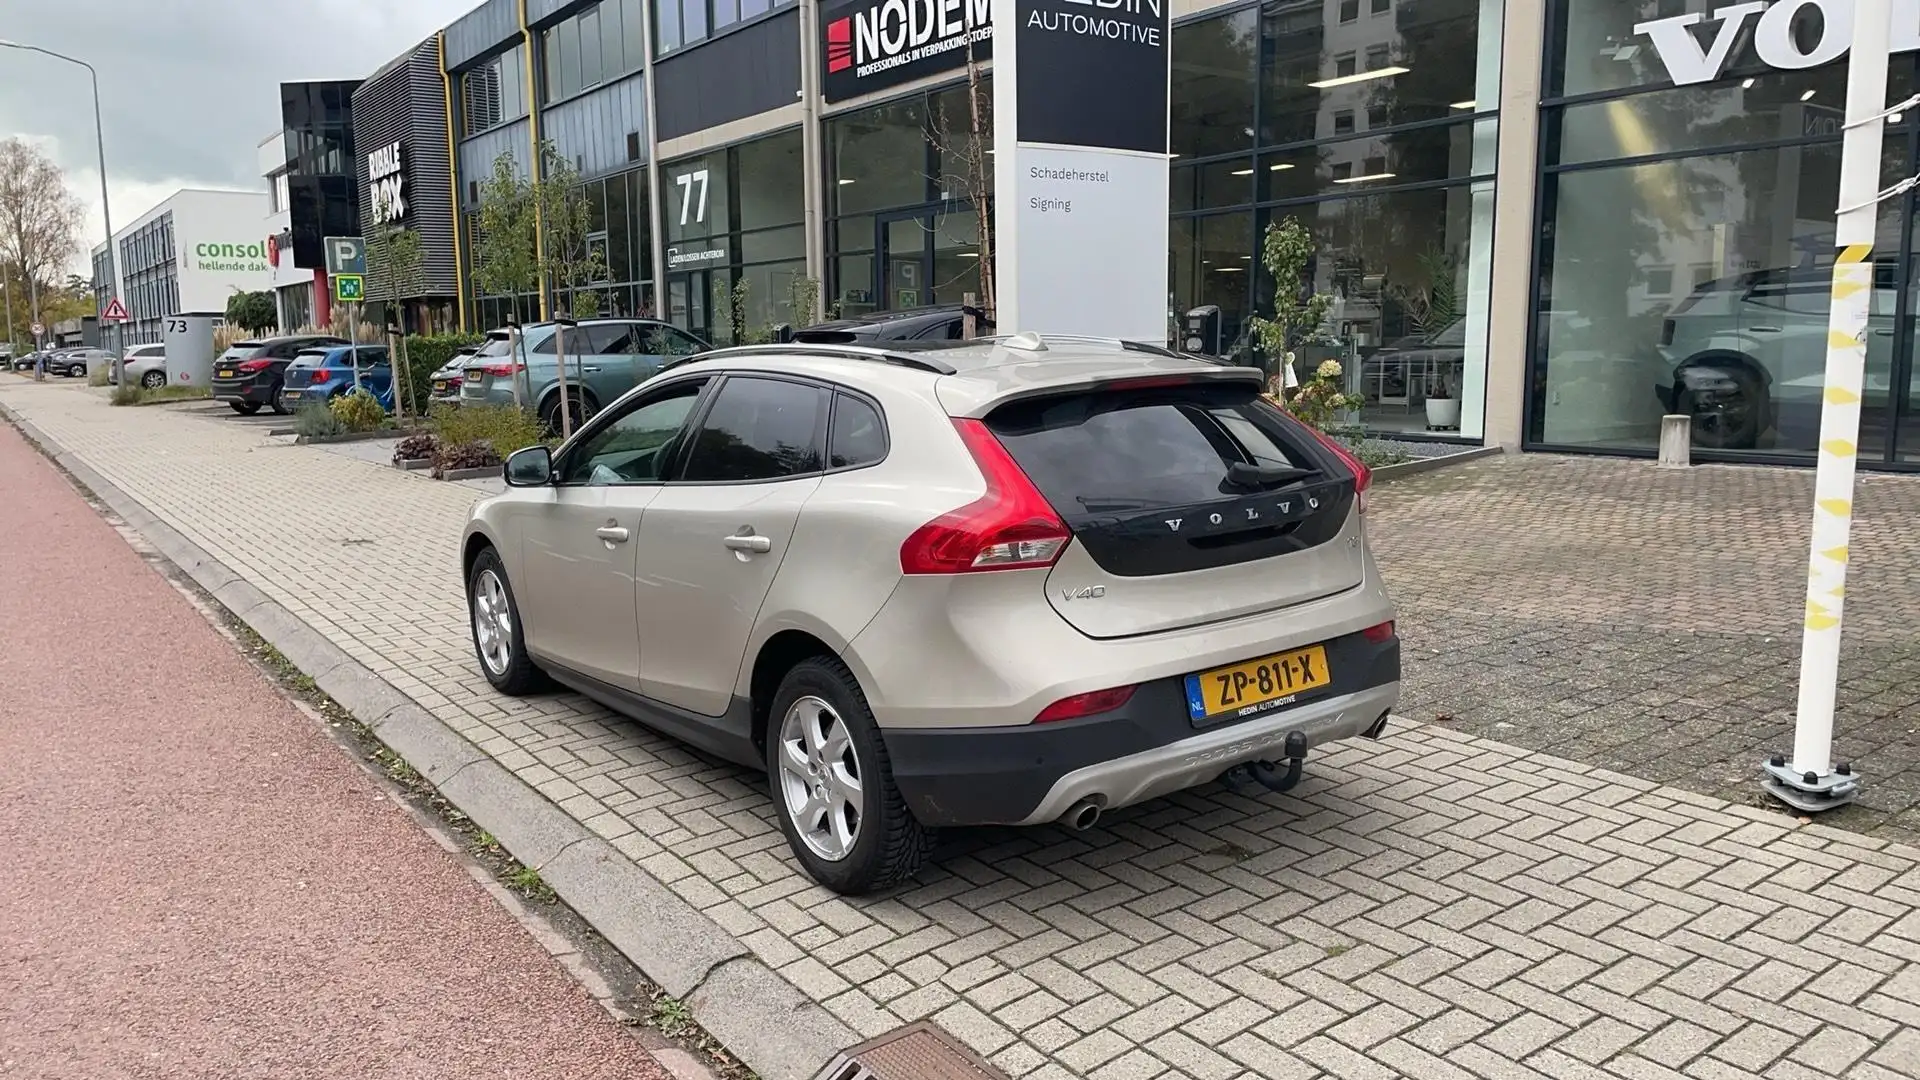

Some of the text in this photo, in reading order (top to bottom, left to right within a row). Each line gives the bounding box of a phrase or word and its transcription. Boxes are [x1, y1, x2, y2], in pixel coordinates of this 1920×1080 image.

[1028, 9, 1160, 47] AUTOMOTIVE
[1634, 0, 1920, 86] VO
[857, 52, 911, 78] PROFESSIONALS
[912, 50, 921, 61] IN
[368, 141, 401, 181] RIBBLE
[1030, 166, 1109, 182] Schadeherstel
[370, 173, 404, 225] BOX
[676, 169, 709, 226] 77
[1030, 197, 1072, 213] Signing
[196, 240, 267, 258] consol
[334, 240, 357, 271] P
[198, 260, 246, 272] hellende
[167, 320, 188, 334] 73
[1165, 497, 1320, 532] VOLVO
[1062, 585, 1106, 601] V40
[1216, 653, 1316, 707] ZP-811-X
[1191, 702, 1204, 713] NL
[1238, 694, 1297, 717] HEDIN AUTOMOTIVE
